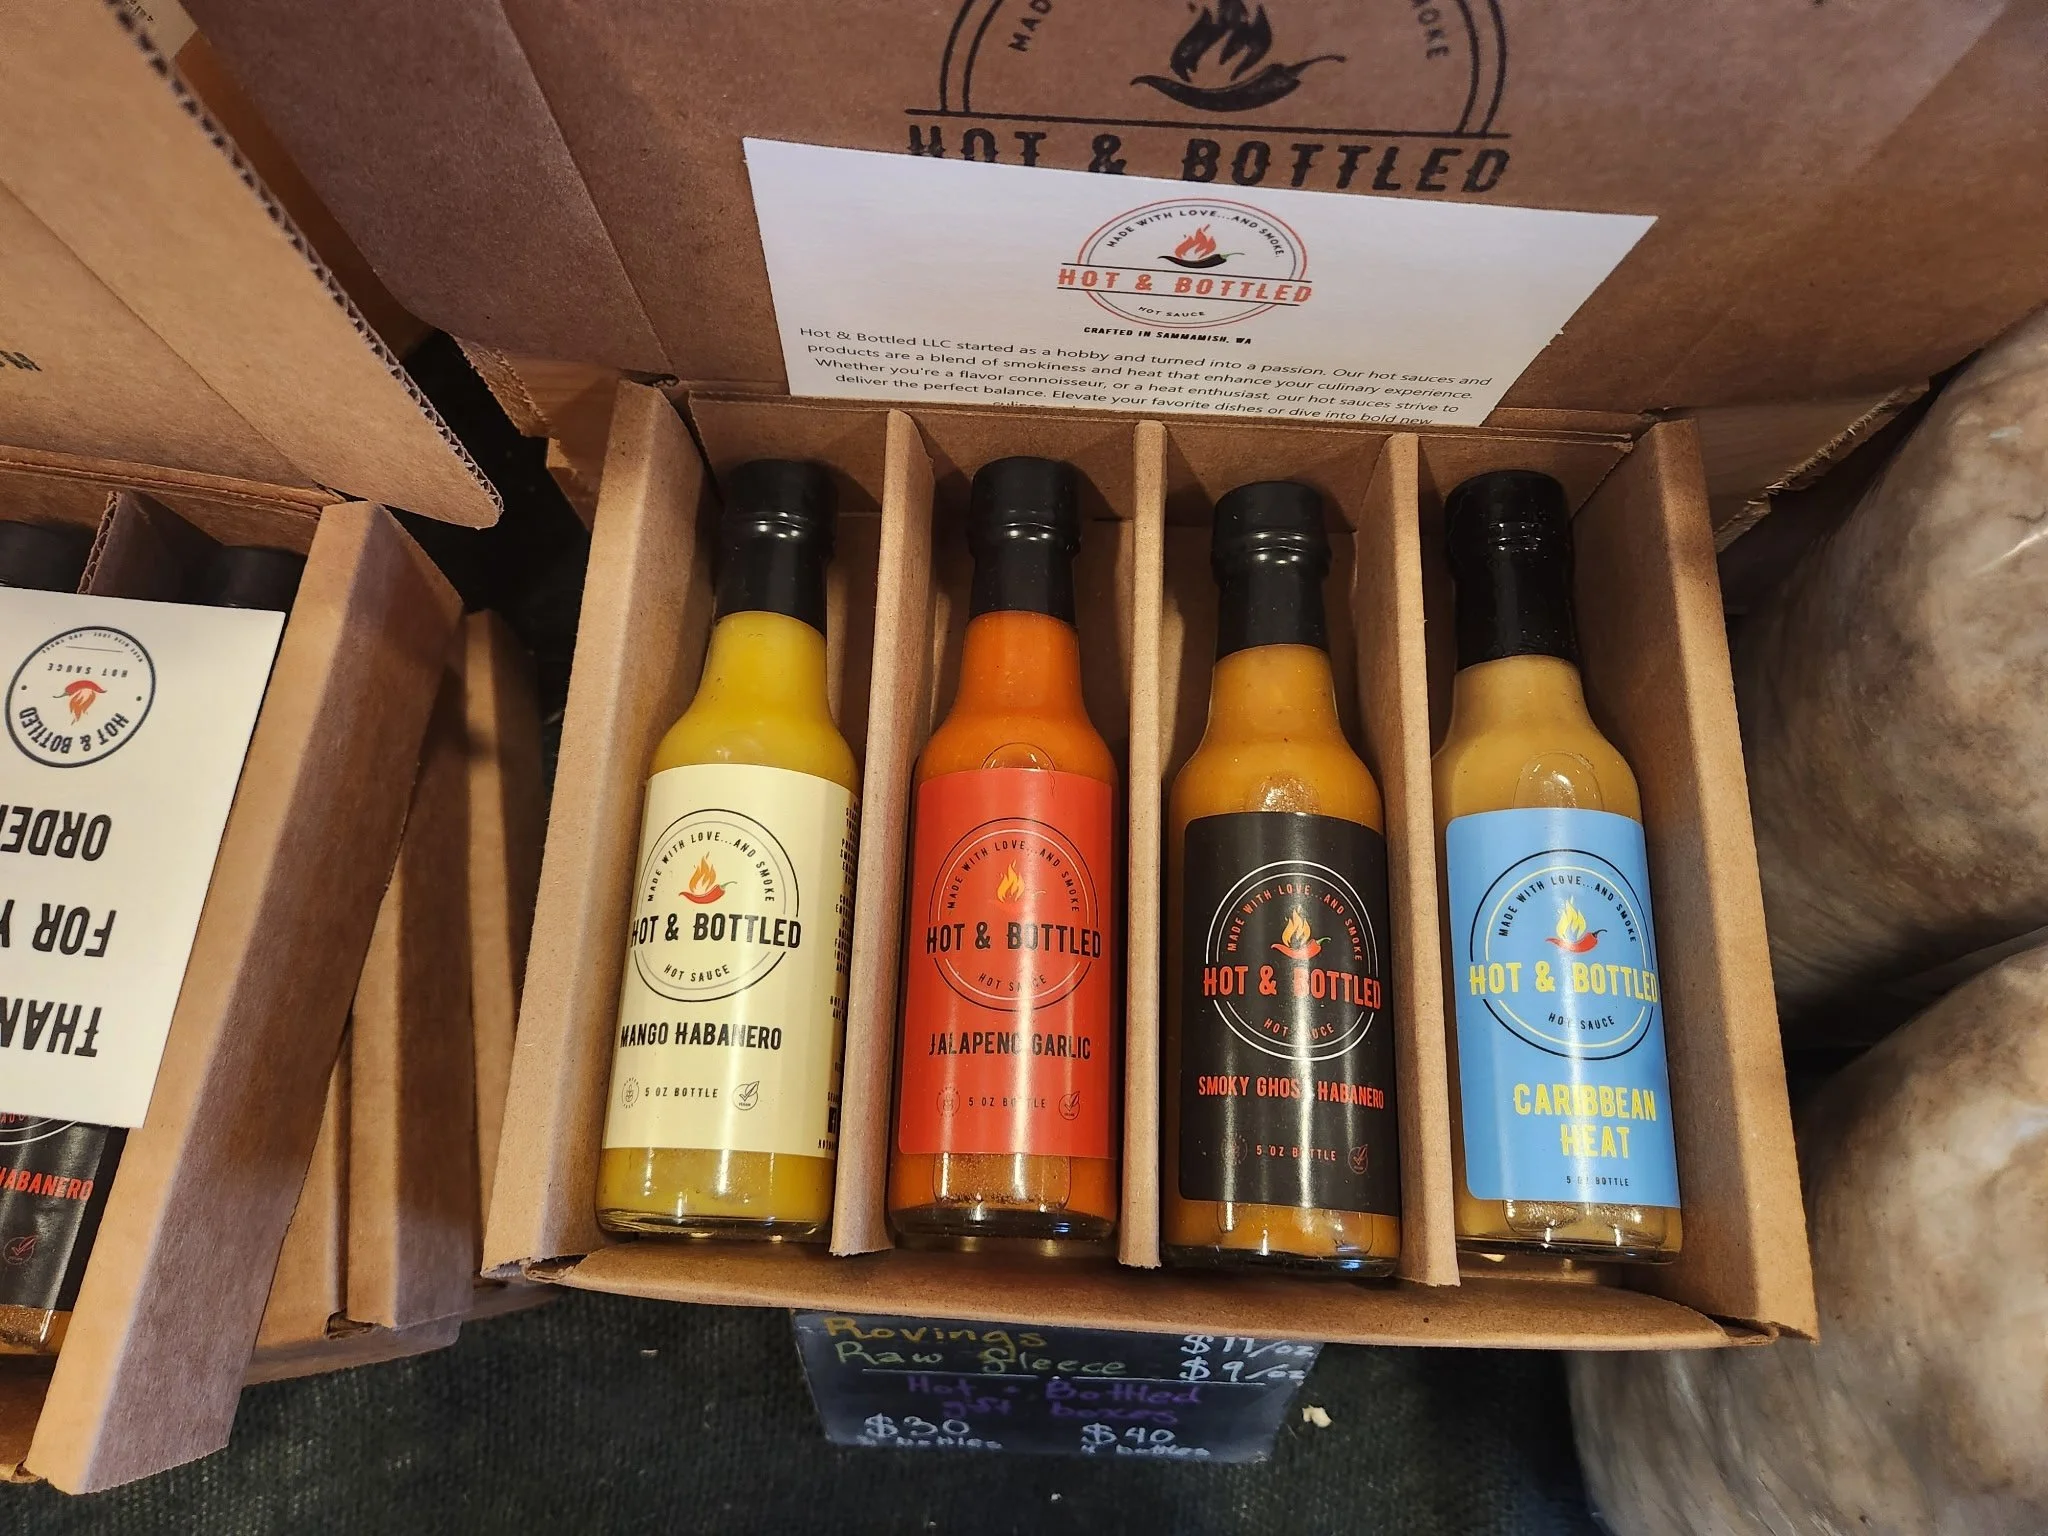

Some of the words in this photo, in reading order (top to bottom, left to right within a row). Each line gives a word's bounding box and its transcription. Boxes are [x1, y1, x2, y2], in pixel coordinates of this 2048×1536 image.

[908, 124, 1047, 167] HOT
[1088, 133, 1127, 174] &
[1181, 137, 1511, 193] BOTTLED
[1106, 226, 1134, 248] MADE
[1136, 212, 1173, 226] WITH
[1057, 268, 1121, 290] HOT
[1135, 274, 1153, 292] &
[1174, 276, 1313, 303] BOTTLED
[1138, 306, 1163, 315] HOT
[1083, 326, 1133, 337] CRAFTED
[1137, 329, 1151, 338] IN
[1235, 336, 1253, 346] WA
[800, 328, 831, 339] Hot
[836, 330, 850, 340] &
[857, 332, 917, 346] Bottled
[923, 336, 952, 349] LLC
[956, 340, 1014, 353] started
[1020, 347, 1037, 356] as
[1042, 348, 1052, 356] a
[1057, 347, 1109, 362] hobby
[1114, 351, 1146, 363] and
[1150, 354, 1207, 367] turned
[1210, 358, 1242, 370] into
[1247, 362, 1256, 371] a
[1261, 363, 1326, 377] passion.
[1332, 368, 1365, 380] Our
[1369, 369, 1396, 381] hot
[1400, 373, 1456, 385] sauces
[1459, 374, 1493, 386] and
[807, 344, 880, 359] products
[885, 351, 911, 361] are
[915, 352, 925, 361] a
[930, 350, 976, 365] blend
[982, 354, 1000, 366] of
[1003, 356, 1087, 372] smokiness
[1091, 362, 1122, 375] and
[1127, 365, 1161, 378] heat
[1167, 367, 1200, 380] that
[1204, 371, 1272, 386] enhance
[1274, 378, 1314, 389] your
[1317, 377, 1381, 394] culinary
[1384, 386, 1474, 400] experience.
[815, 358, 885, 373] Whether
[890, 365, 940, 379] you're
[944, 370, 954, 379] a
[960, 369, 1004, 381] flavor
[1009, 373, 1108, 390] connoisseur,
[1113, 382, 1131, 391] or
[1135, 383, 1144, 391] a
[1149, 382, 1184, 394] heat
[1188, 386, 1271, 402] enthusiast,
[1276, 394, 1303, 403] our
[1308, 392, 1336, 404] hot
[1339, 396, 1392, 409] sauces
[1396, 398, 1439, 412] strive
[1442, 402, 1459, 413] to
[835, 374, 889, 389] deliver
[893, 377, 919, 390] the
[923, 380, 979, 395] perfect
[984, 384, 1046, 398] balance.
[1052, 389, 1107, 402] Elevate
[1110, 395, 1148, 407] your
[1151, 396, 1211, 411] favorite
[1214, 399, 1264, 415] dishes
[1268, 406, 1286, 415] or
[1289, 406, 1321, 418] dive
[1326, 409, 1356, 420] into
[1360, 411, 1397, 423] bold
[1400, 416, 1433, 425] new
[47, 662, 92, 675] SAUCE
[101, 668, 128, 678] HOT
[19, 707, 73, 754] BOTTLED
[80, 734, 92, 752] &
[96, 712, 130, 745] HOT
[647, 869, 662, 902] MADE
[662, 837, 687, 866] WITH
[756, 860, 776, 903] SMOKE
[946, 874, 963, 911] MADE
[962, 846, 989, 872] WITH
[1061, 869, 1080, 913] SMOKE
[1227, 917, 1245, 952] MADE
[1243, 889, 1272, 914] WITH
[1345, 918, 1363, 961] SMOKE
[1498, 905, 1518, 937] MADE
[1516, 880, 1545, 903] WITH
[1616, 904, 1637, 943] SMOKE
[31, 902, 117, 958] FOR
[630, 914, 660, 949] HOT
[664, 913, 680, 942] &
[693, 912, 802, 950] BOTTLED
[926, 923, 965, 956] HOT
[975, 921, 991, 950] &
[1006, 921, 1102, 960] BOTTLED
[664, 964, 686, 982] HOT
[690, 964, 731, 983] SAUCE
[978, 973, 1001, 989] HOT
[1009, 974, 1047, 992] SACE
[1203, 965, 1249, 997] HOT
[1259, 965, 1277, 996] &
[1293, 967, 1381, 1010] BOTTLED
[1469, 962, 1522, 995] HOT
[1535, 961, 1556, 993] &
[1572, 962, 1658, 1004] BOTTLED
[620, 1022, 669, 1049] MANGO
[674, 1021, 783, 1051] HABANERO
[1263, 1018, 1289, 1037] HOT
[1297, 1022, 1335, 1040] UCE
[1580, 1015, 1615, 1030] SAUCE
[1031, 1033, 1091, 1059] GARLIC
[645, 1086, 650, 1097] 5
[655, 1086, 668, 1097] OZ
[674, 1087, 718, 1098] BOTTLE
[968, 1096, 974, 1107] 5
[981, 1097, 995, 1107] OZ
[1198, 1075, 1250, 1097] SMOKY
[1256, 1076, 1305, 1099] GHOS
[1317, 1081, 1385, 1109] HABANERO
[1513, 1083, 1657, 1122] CARIBBEAN
[1256, 1144, 1262, 1156] 5
[1269, 1145, 1284, 1157] OZ
[1292, 1147, 1336, 1161] BTTLE
[1560, 1123, 1630, 1160] HEAT
[1566, 1175, 1571, 1184] 5
[1595, 1176, 1630, 1187] BOTTLE
[823, 1316, 1048, 1362] Rovings
[833, 1341, 944, 1367] Raw
[907, 1375, 976, 1397] Hot
